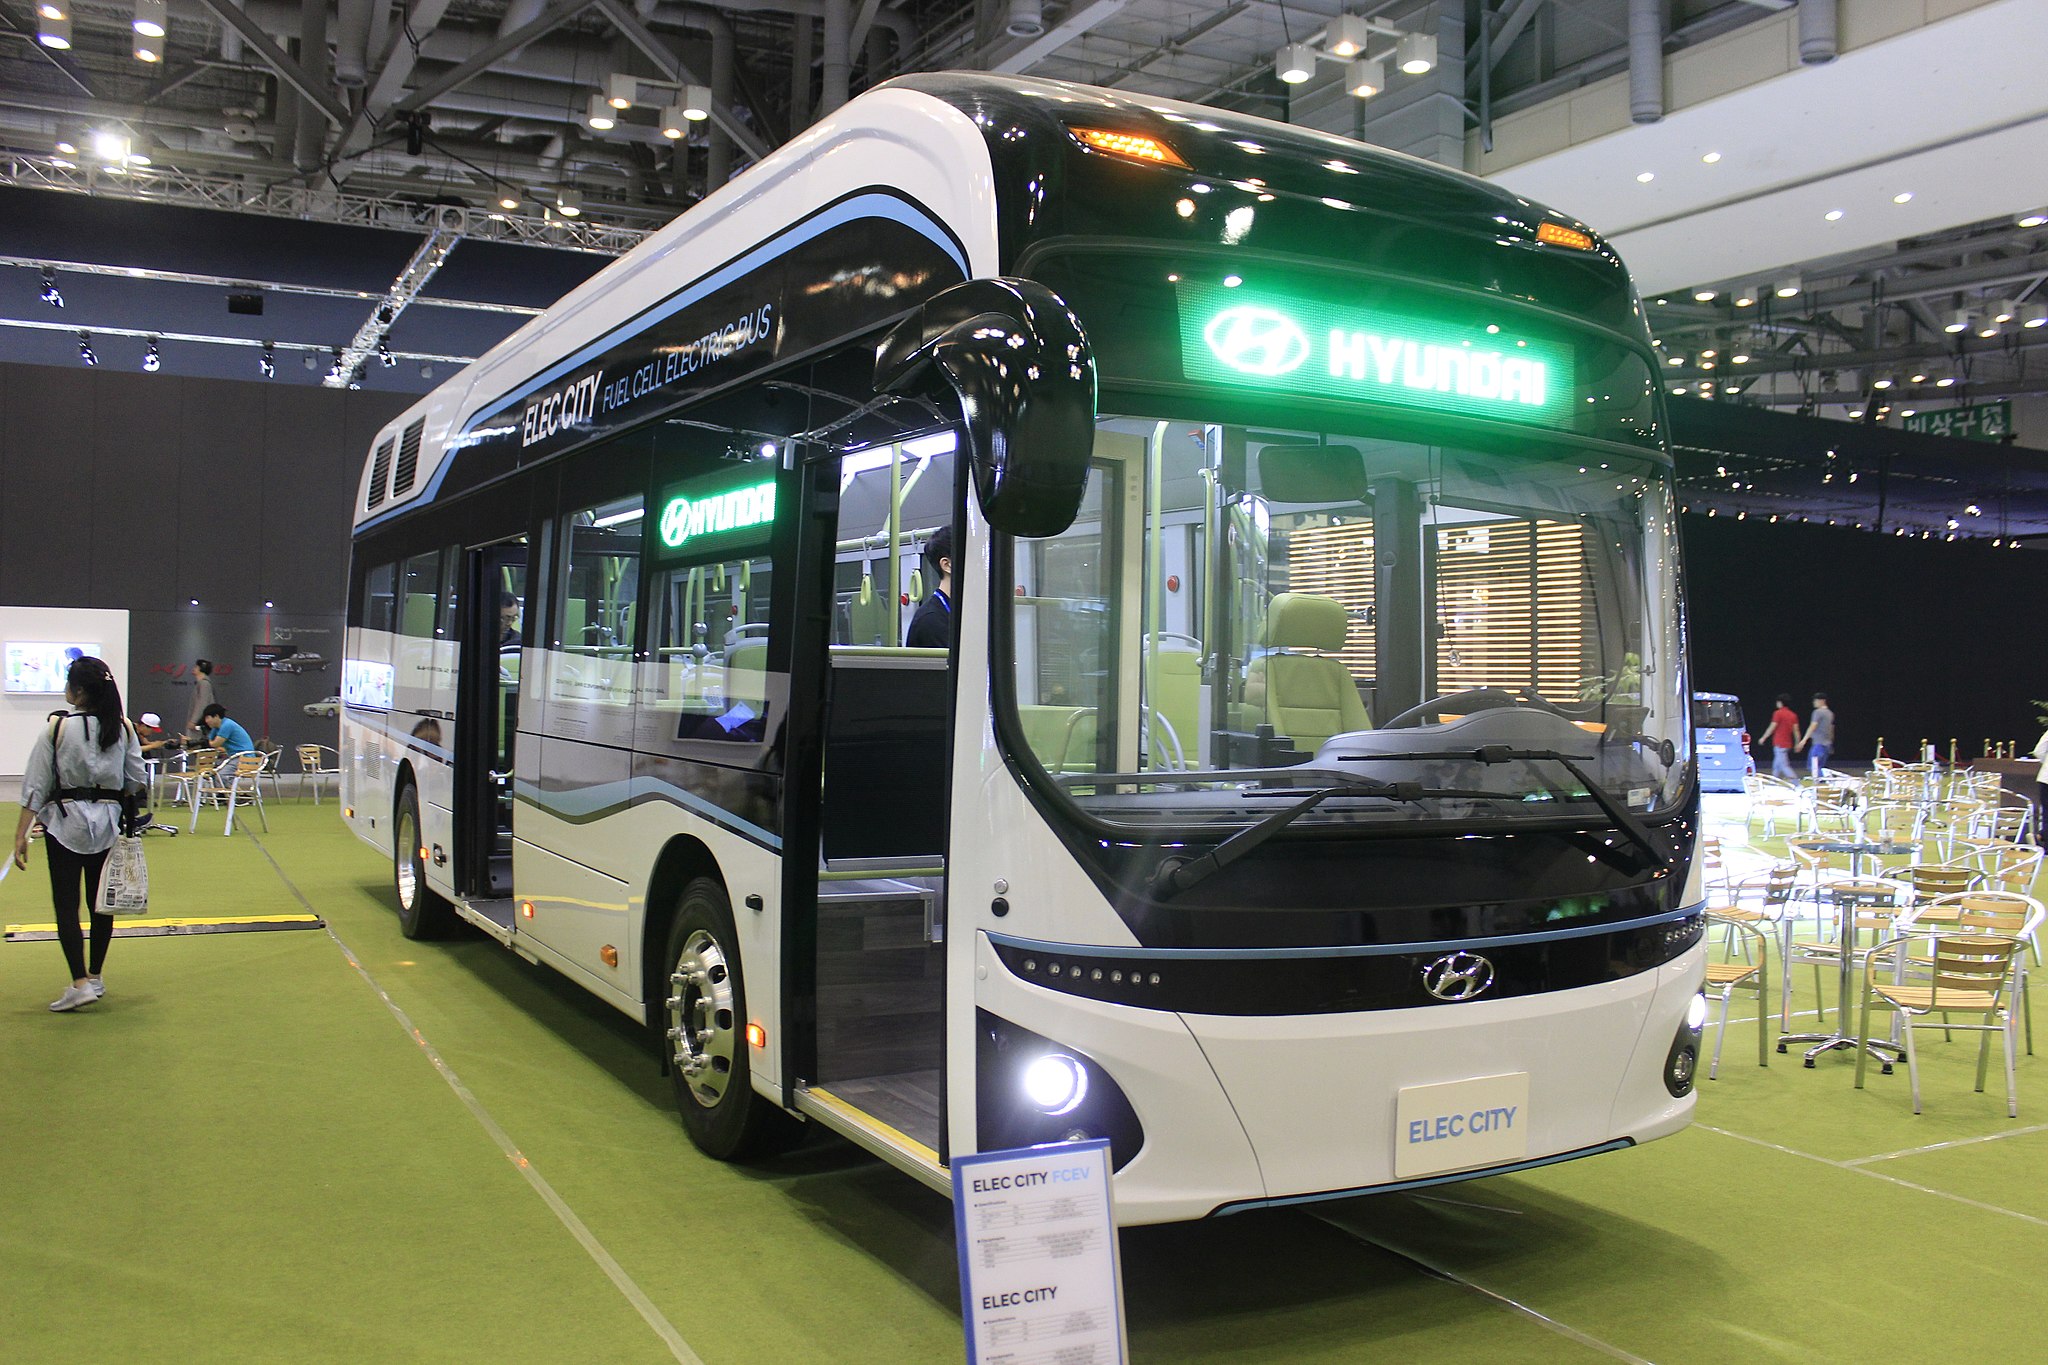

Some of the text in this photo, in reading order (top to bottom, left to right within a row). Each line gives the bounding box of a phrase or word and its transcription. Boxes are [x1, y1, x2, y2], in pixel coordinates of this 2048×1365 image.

[522, 303, 772, 448] ELEC CITY FUEL CELL ELECTRIC BUS
[1329, 329, 1545, 406] HYUNDAI
[1908, 411, 1976, 437] 비상구
[1409, 1106, 1518, 1143] ELEC CITY
[973, 1166, 1090, 1193] ELEC CITY FCEV
[982, 1286, 1058, 1310] ELEC CITY
